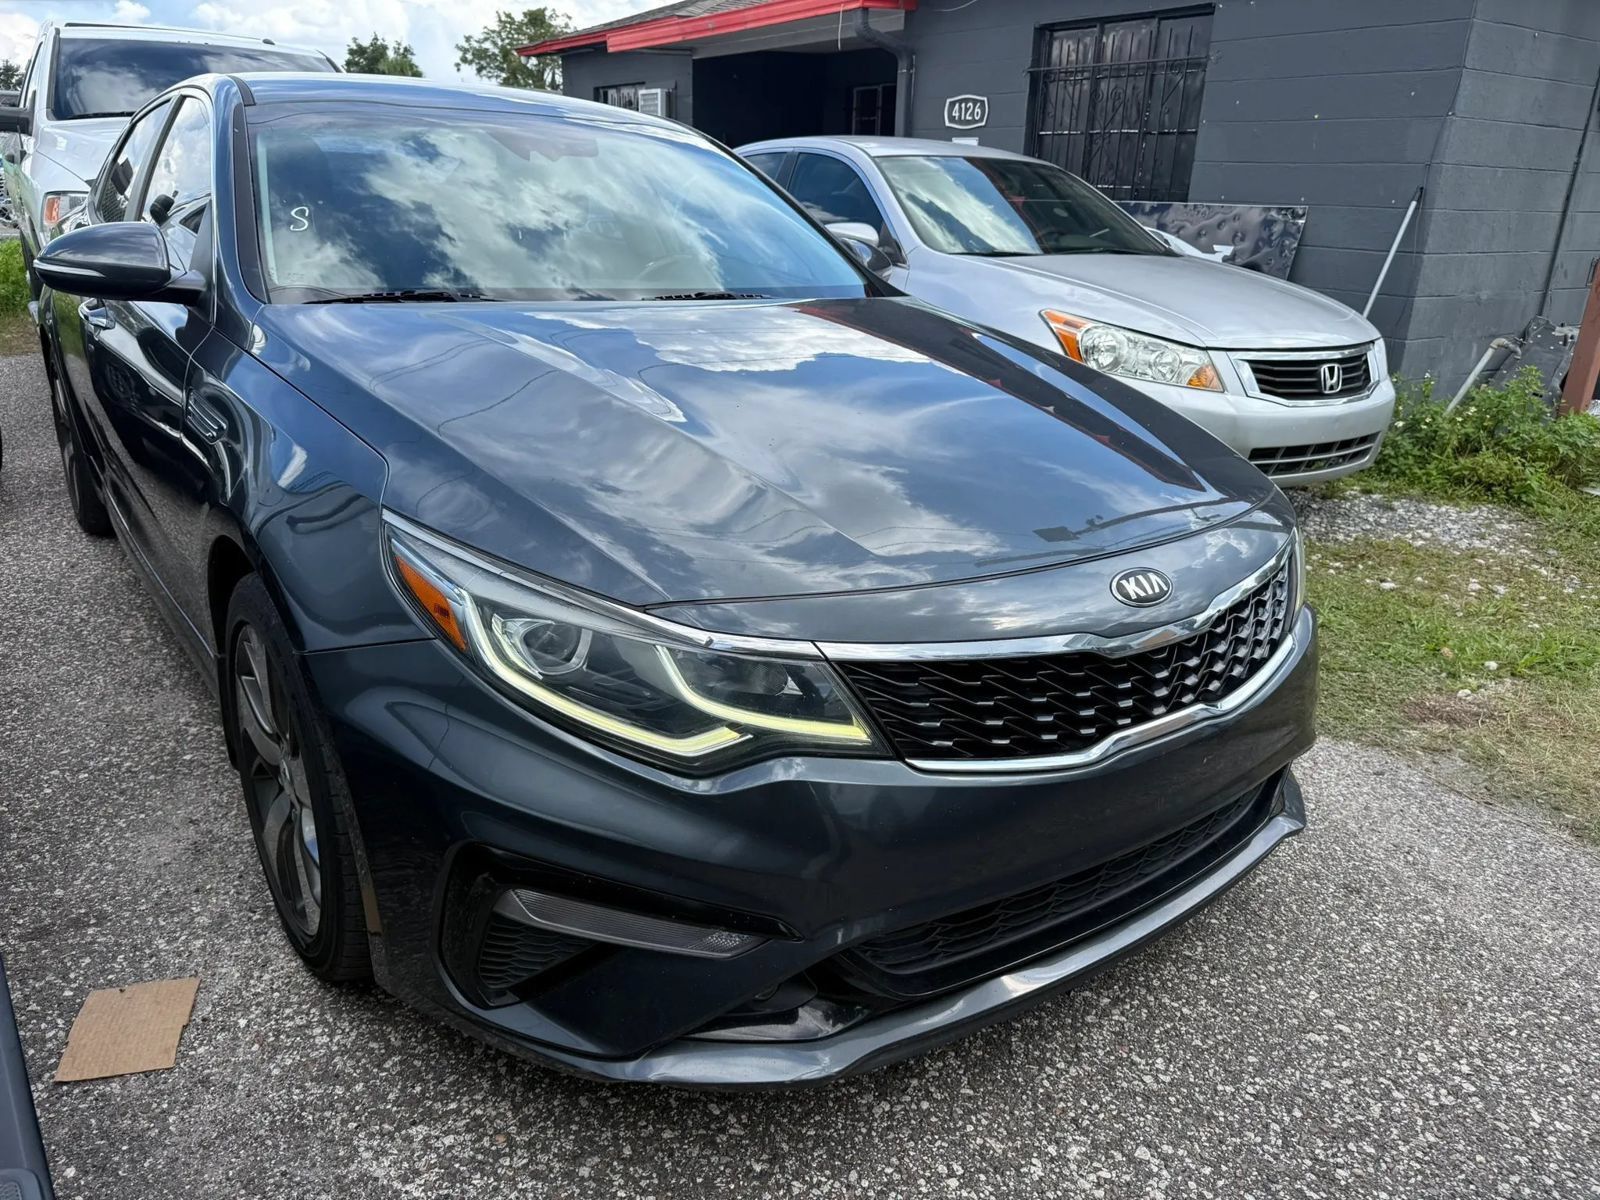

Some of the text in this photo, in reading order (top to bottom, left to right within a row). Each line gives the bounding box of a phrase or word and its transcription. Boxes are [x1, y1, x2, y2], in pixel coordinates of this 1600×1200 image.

[952, 102, 981, 120] 4126
[290, 206, 309, 231] S
[1120, 572, 1168, 600] KIA
